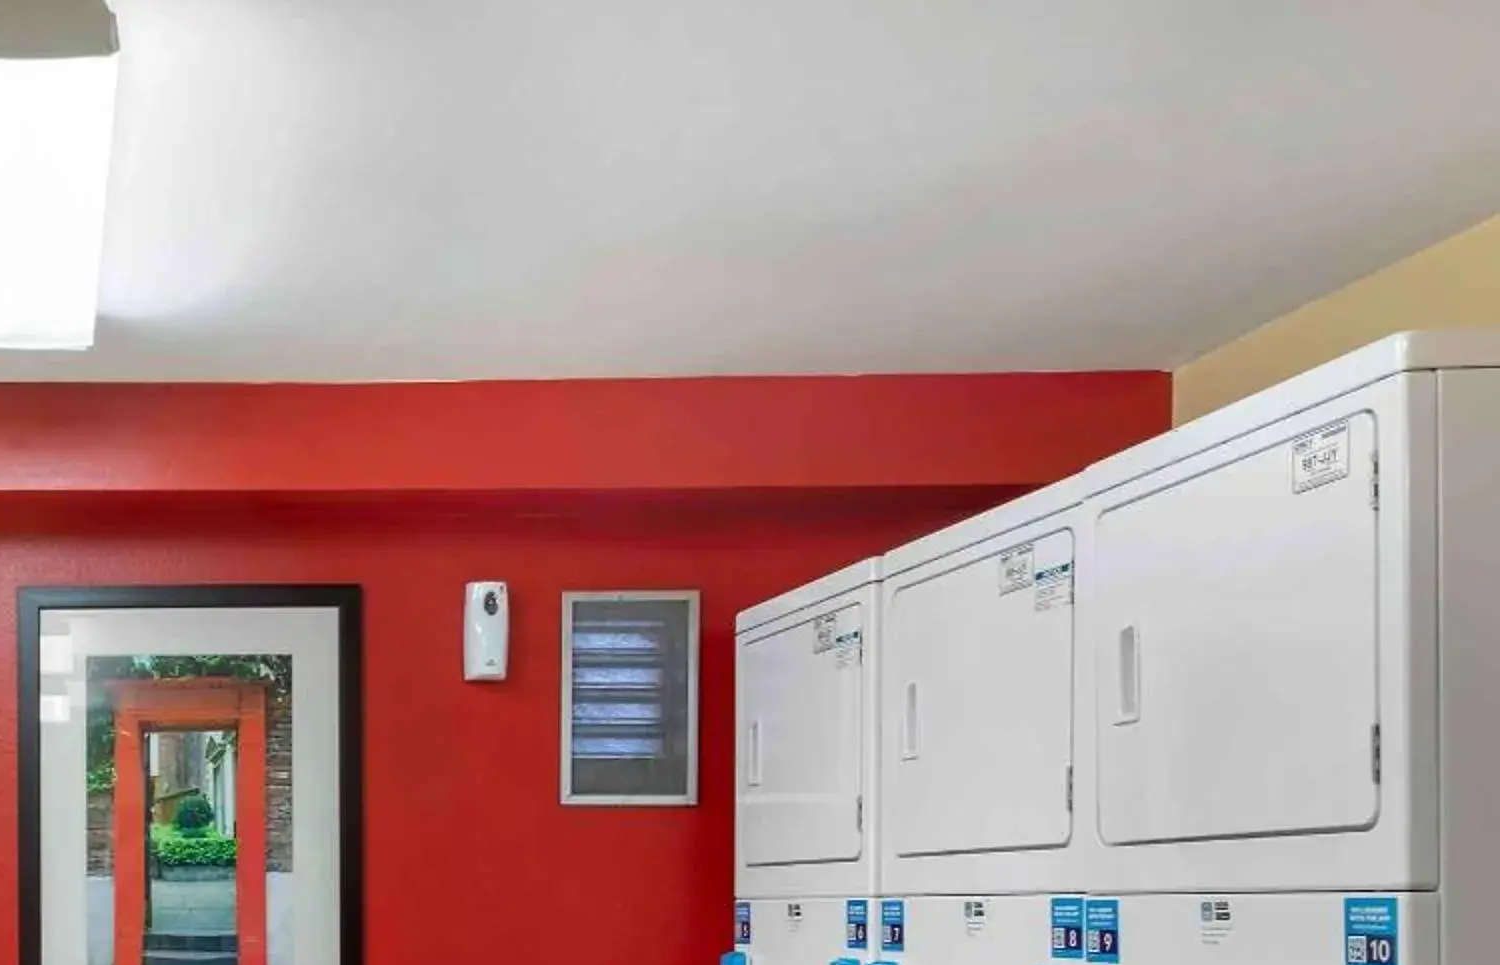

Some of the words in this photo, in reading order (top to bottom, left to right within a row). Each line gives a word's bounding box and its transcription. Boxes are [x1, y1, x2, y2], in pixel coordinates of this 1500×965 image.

[893, 927, 901, 941] 7
[1068, 929, 1077, 947] 8
[1103, 932, 1113, 952] 9
[1369, 939, 1391, 963] 10
